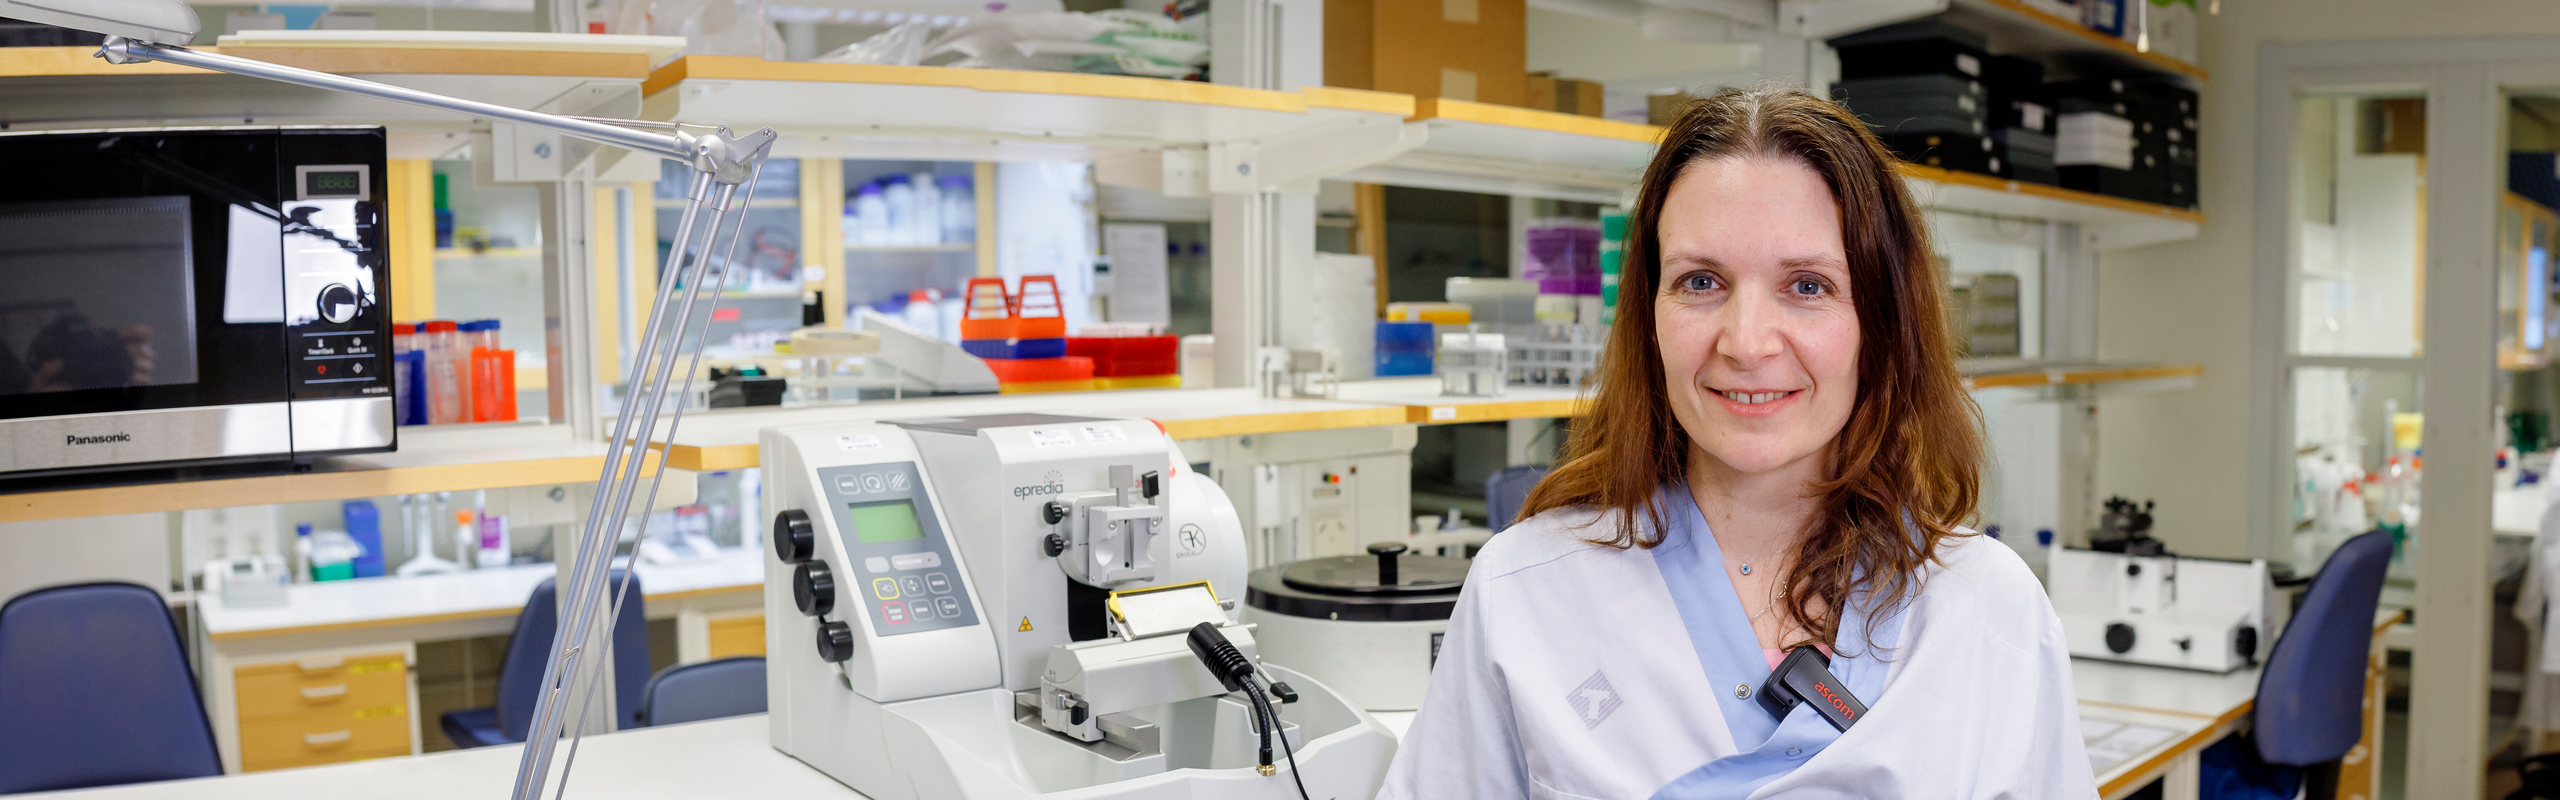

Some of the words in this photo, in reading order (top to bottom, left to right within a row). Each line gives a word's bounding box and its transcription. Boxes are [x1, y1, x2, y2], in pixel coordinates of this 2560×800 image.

[66, 430, 131, 446] Panasonic
[1013, 480, 1064, 501] epredia
[1813, 680, 1855, 720] ascom
